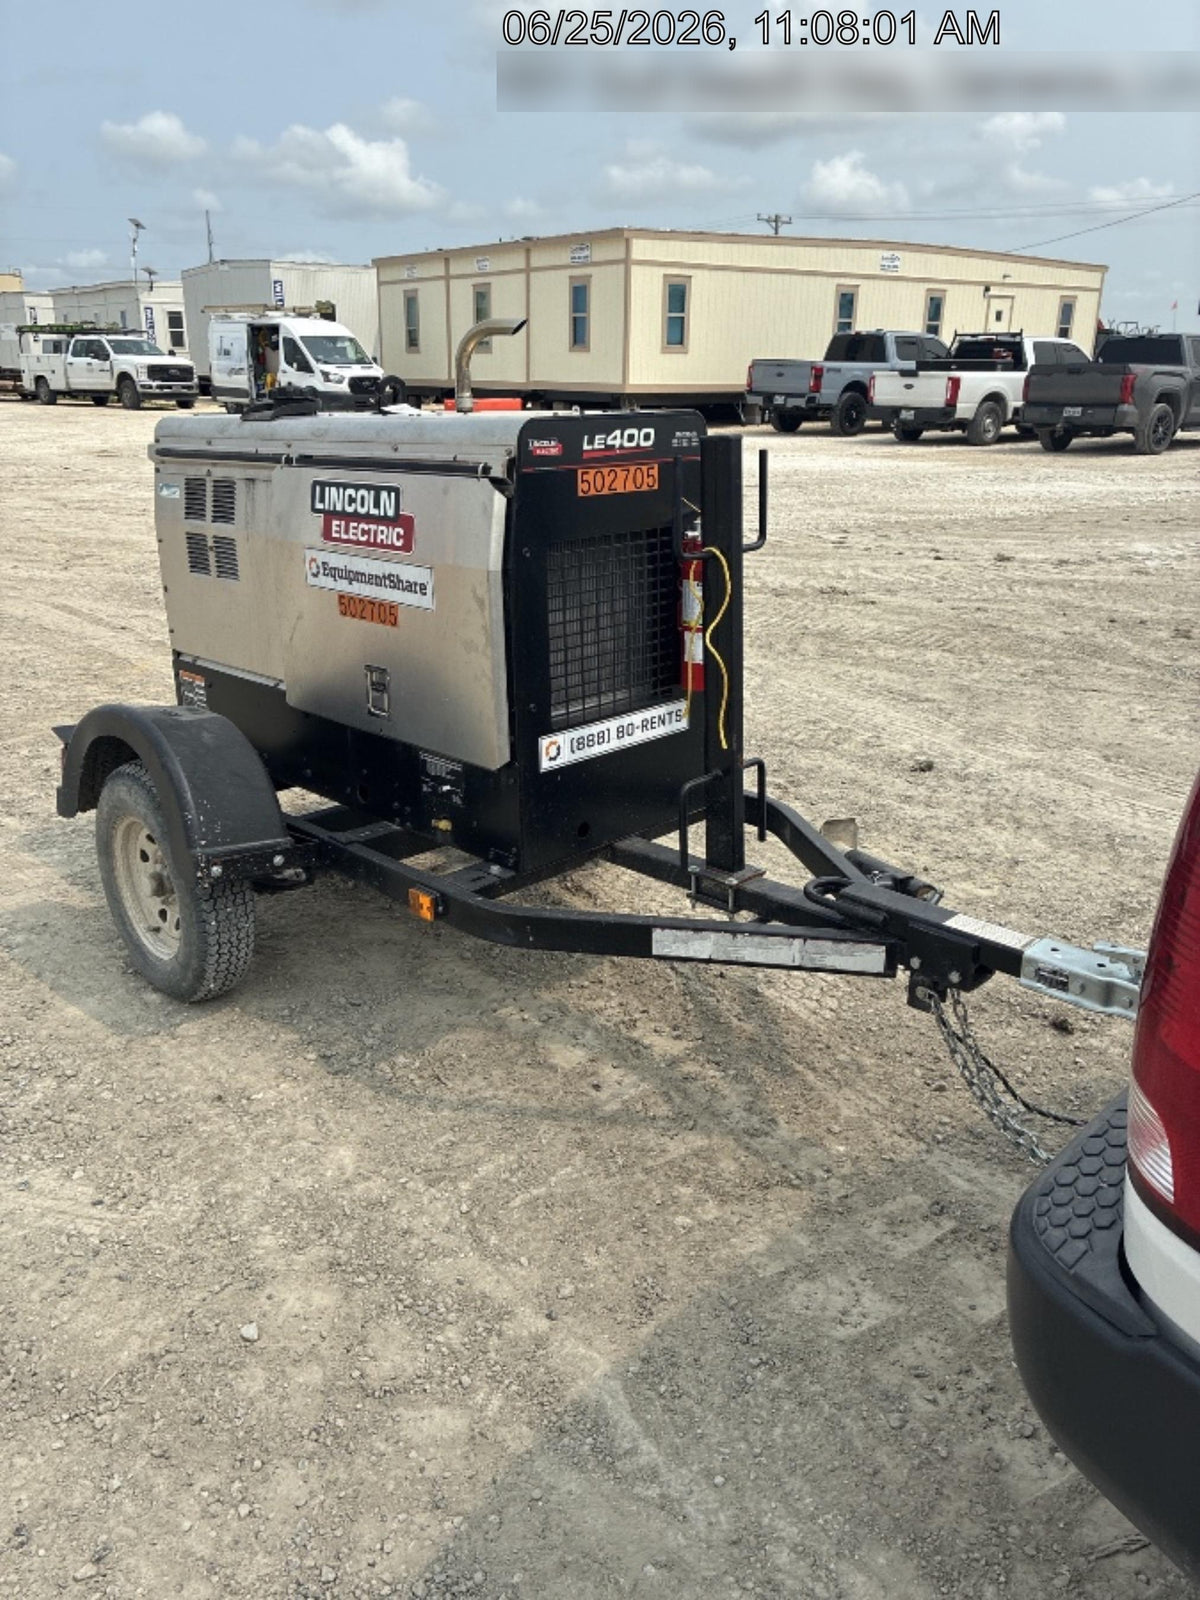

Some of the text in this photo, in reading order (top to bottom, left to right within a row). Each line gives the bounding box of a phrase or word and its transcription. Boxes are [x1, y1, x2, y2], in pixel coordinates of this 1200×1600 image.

[582, 427, 656, 450] LE400
[579, 466, 657, 494] 502705
[314, 485, 396, 518] LINCOLN
[331, 519, 404, 547] ELECTRIC
[321, 561, 428, 596] EquipmentShare
[338, 595, 398, 626] 502705
[616, 708, 683, 739] 80-RENTS
